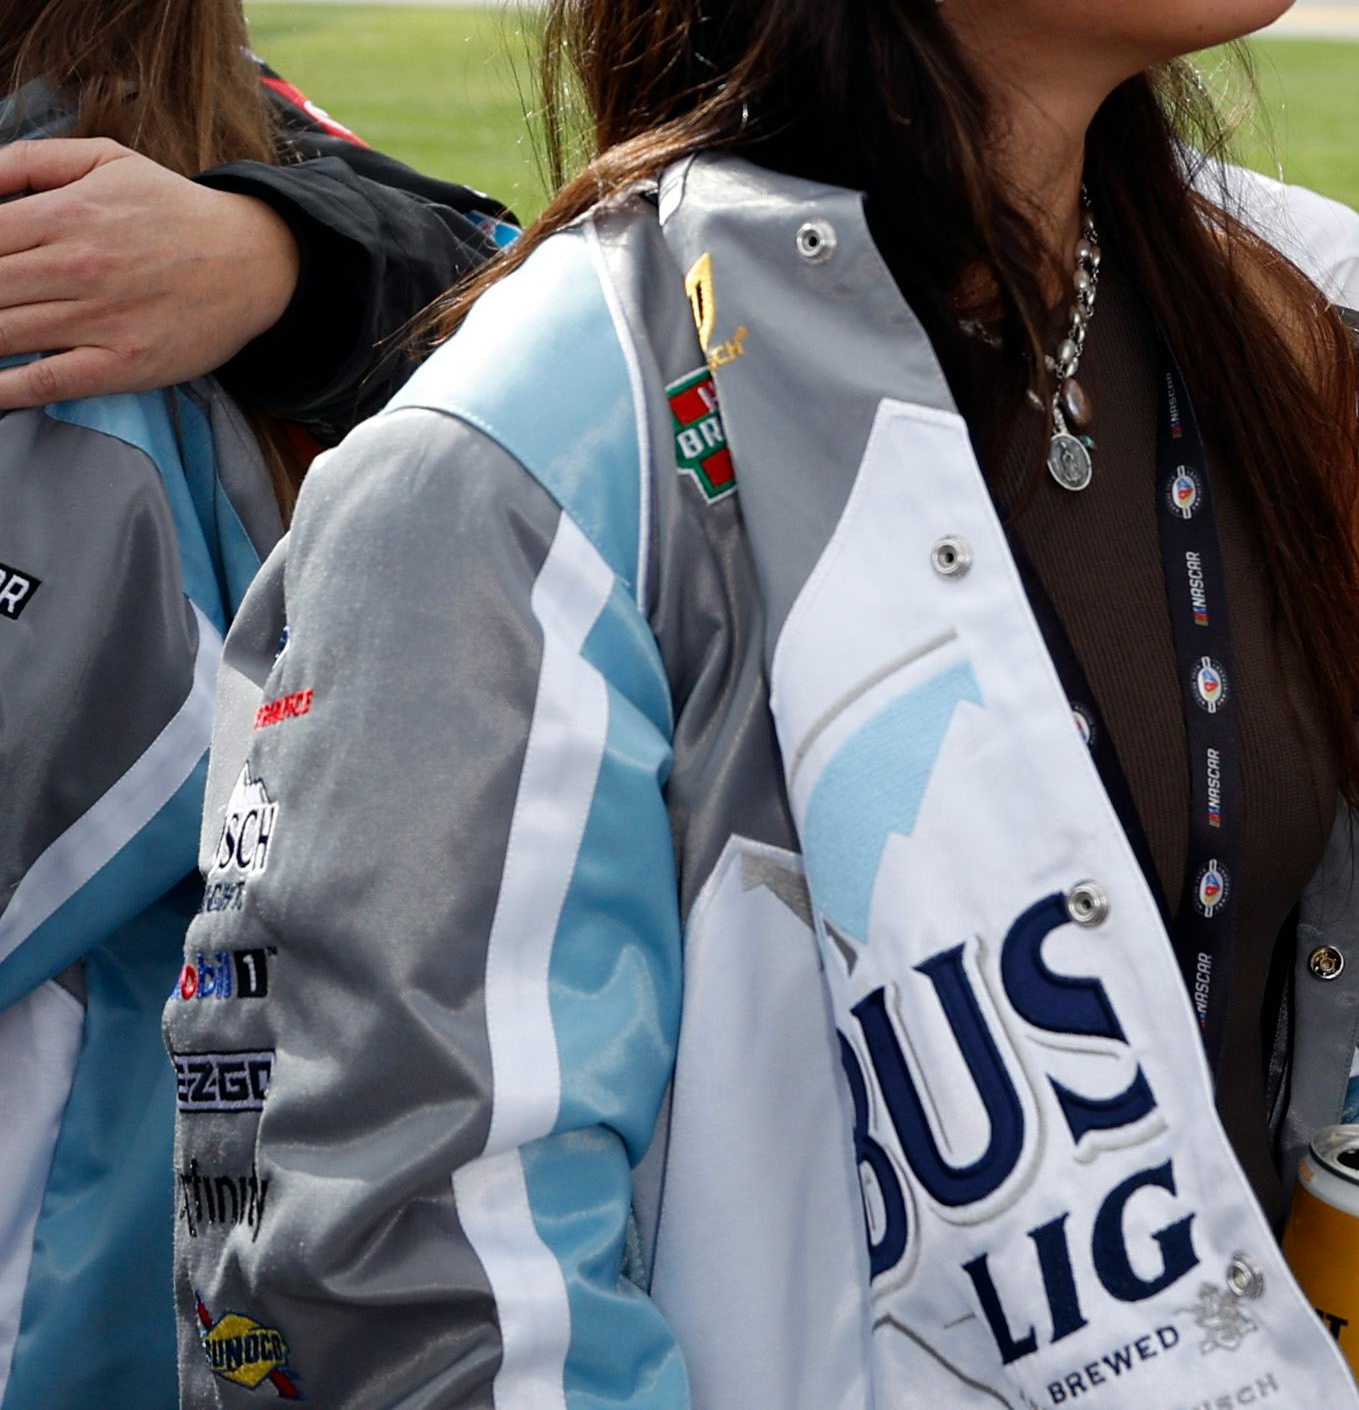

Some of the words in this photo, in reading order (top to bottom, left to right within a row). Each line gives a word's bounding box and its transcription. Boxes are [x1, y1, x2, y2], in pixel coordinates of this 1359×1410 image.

[1184, 551, 1202, 614] NASCAR
[1208, 747, 1221, 809] NASCAR
[1047, 1324, 1181, 1406] BREWED
